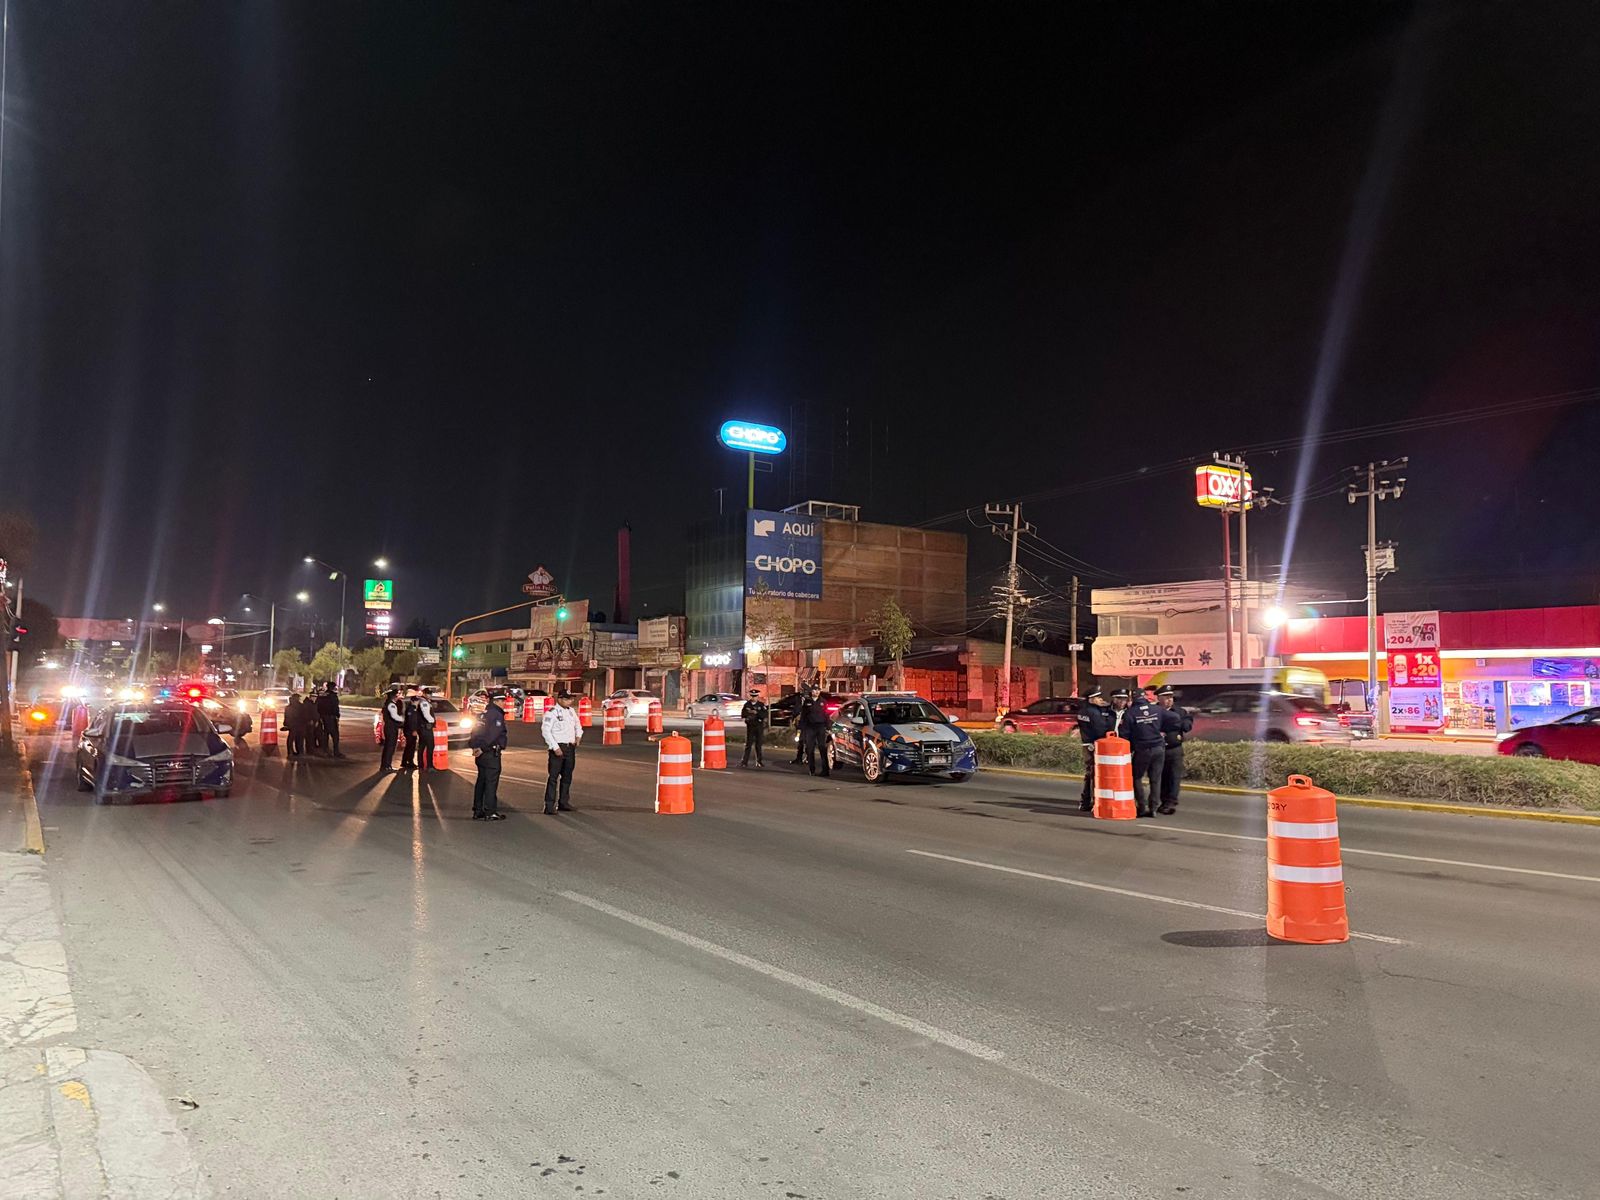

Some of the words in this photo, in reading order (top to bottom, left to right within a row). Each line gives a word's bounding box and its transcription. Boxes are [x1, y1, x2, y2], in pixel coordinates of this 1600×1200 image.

[782, 522, 814, 537] AQUÍ
[754, 554, 816, 575] CHOPO
[795, 591, 819, 599] cabecera
[1130, 658, 1183, 666] CAPITAL
[1415, 653, 1433, 664] 1x
[1412, 664, 1438, 676] $20
